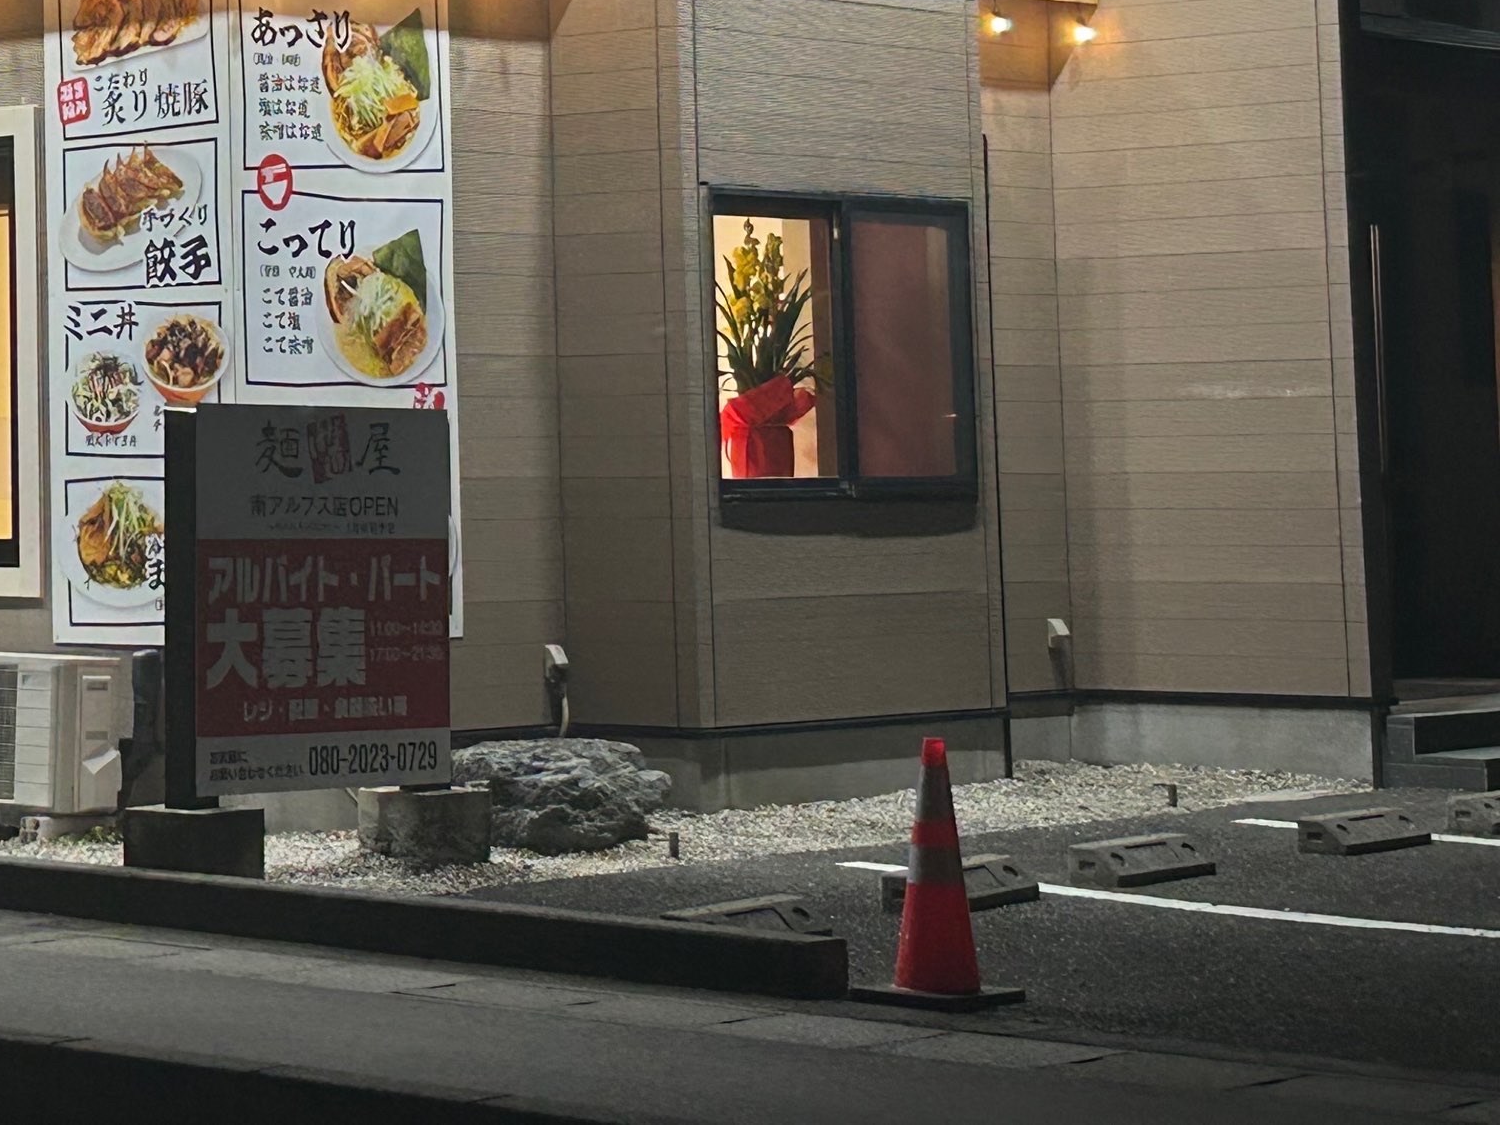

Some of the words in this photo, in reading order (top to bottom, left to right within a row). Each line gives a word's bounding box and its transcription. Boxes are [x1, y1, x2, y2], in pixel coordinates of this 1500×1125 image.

[252, 6, 351, 52] あっさり
[94, 68, 148, 92] こだわり
[256, 218, 356, 260] こってり
[145, 236, 211, 286] 餃子
[63, 303, 139, 341] ミニ丼
[207, 606, 366, 690] 大募集
[308, 741, 438, 776] 080-2023-0729
